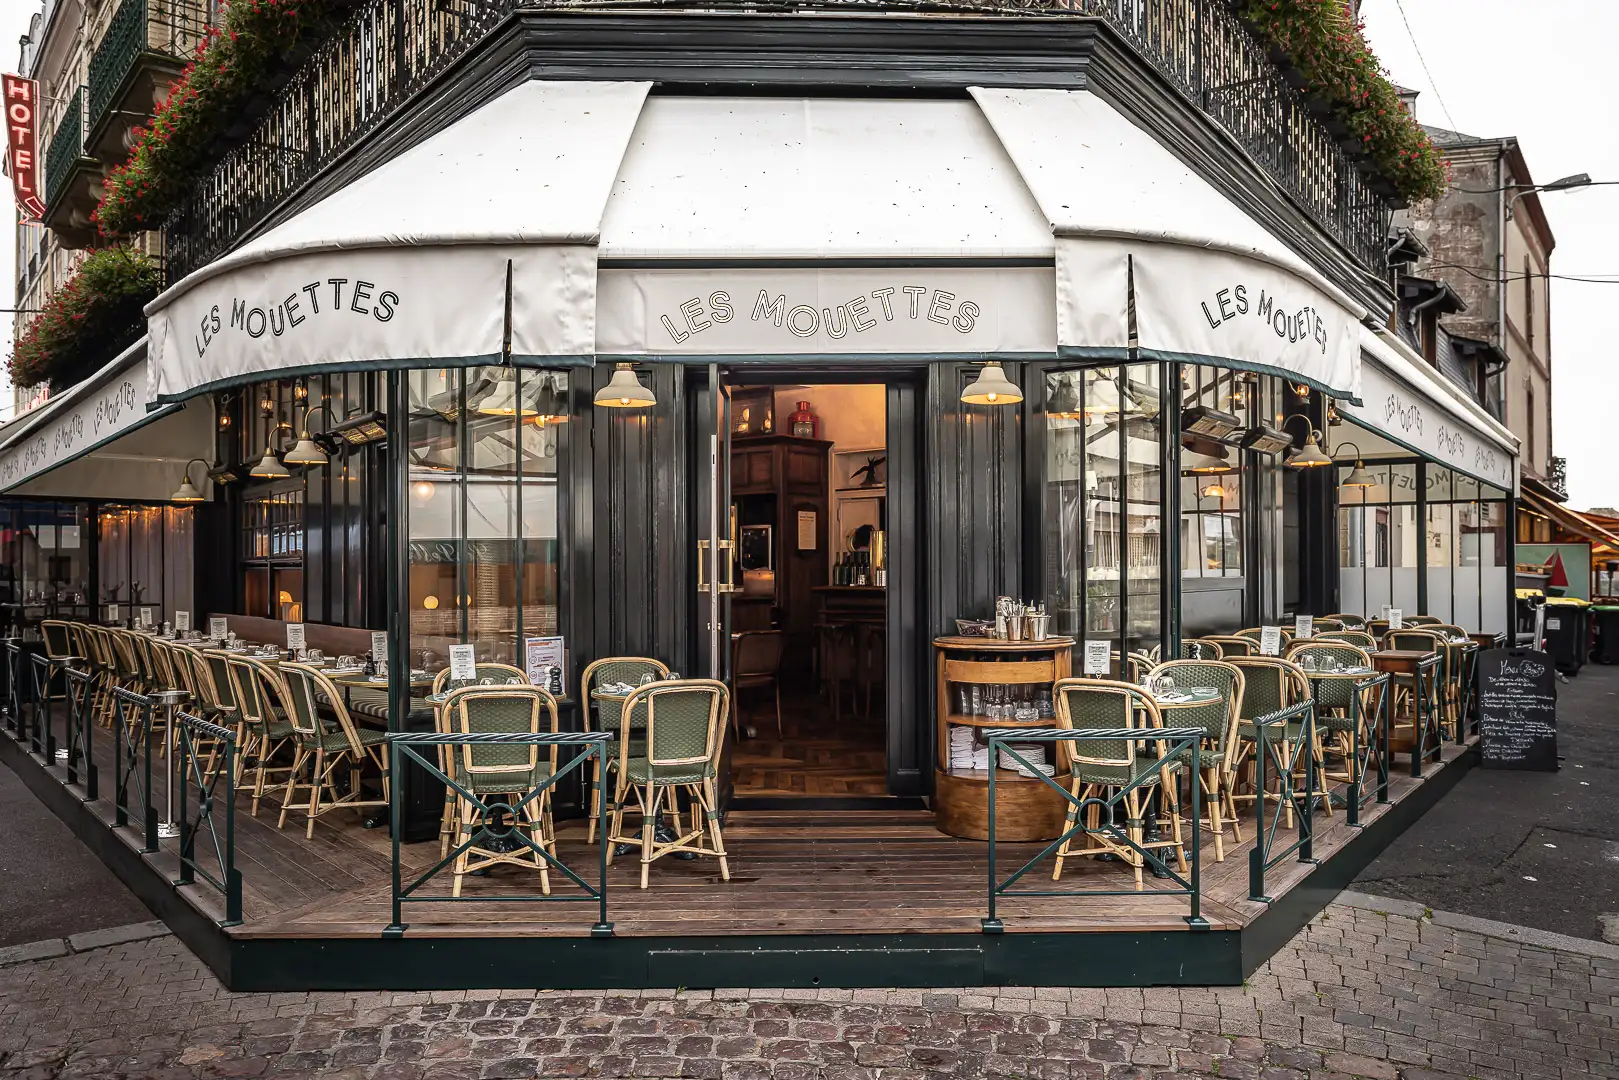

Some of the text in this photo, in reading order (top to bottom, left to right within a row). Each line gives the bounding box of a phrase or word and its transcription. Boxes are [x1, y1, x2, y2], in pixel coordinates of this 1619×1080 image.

[7, 79, 32, 193] HOTEL
[195, 278, 399, 358] LES MOUETTES
[660, 286, 981, 344] LES MOUETTES
[1201, 284, 1249, 330] LES
[93, 400, 104, 436] LES
[103, 381, 136, 425] MOUETTES
[1384, 393, 1423, 437] LES MOUETTES
